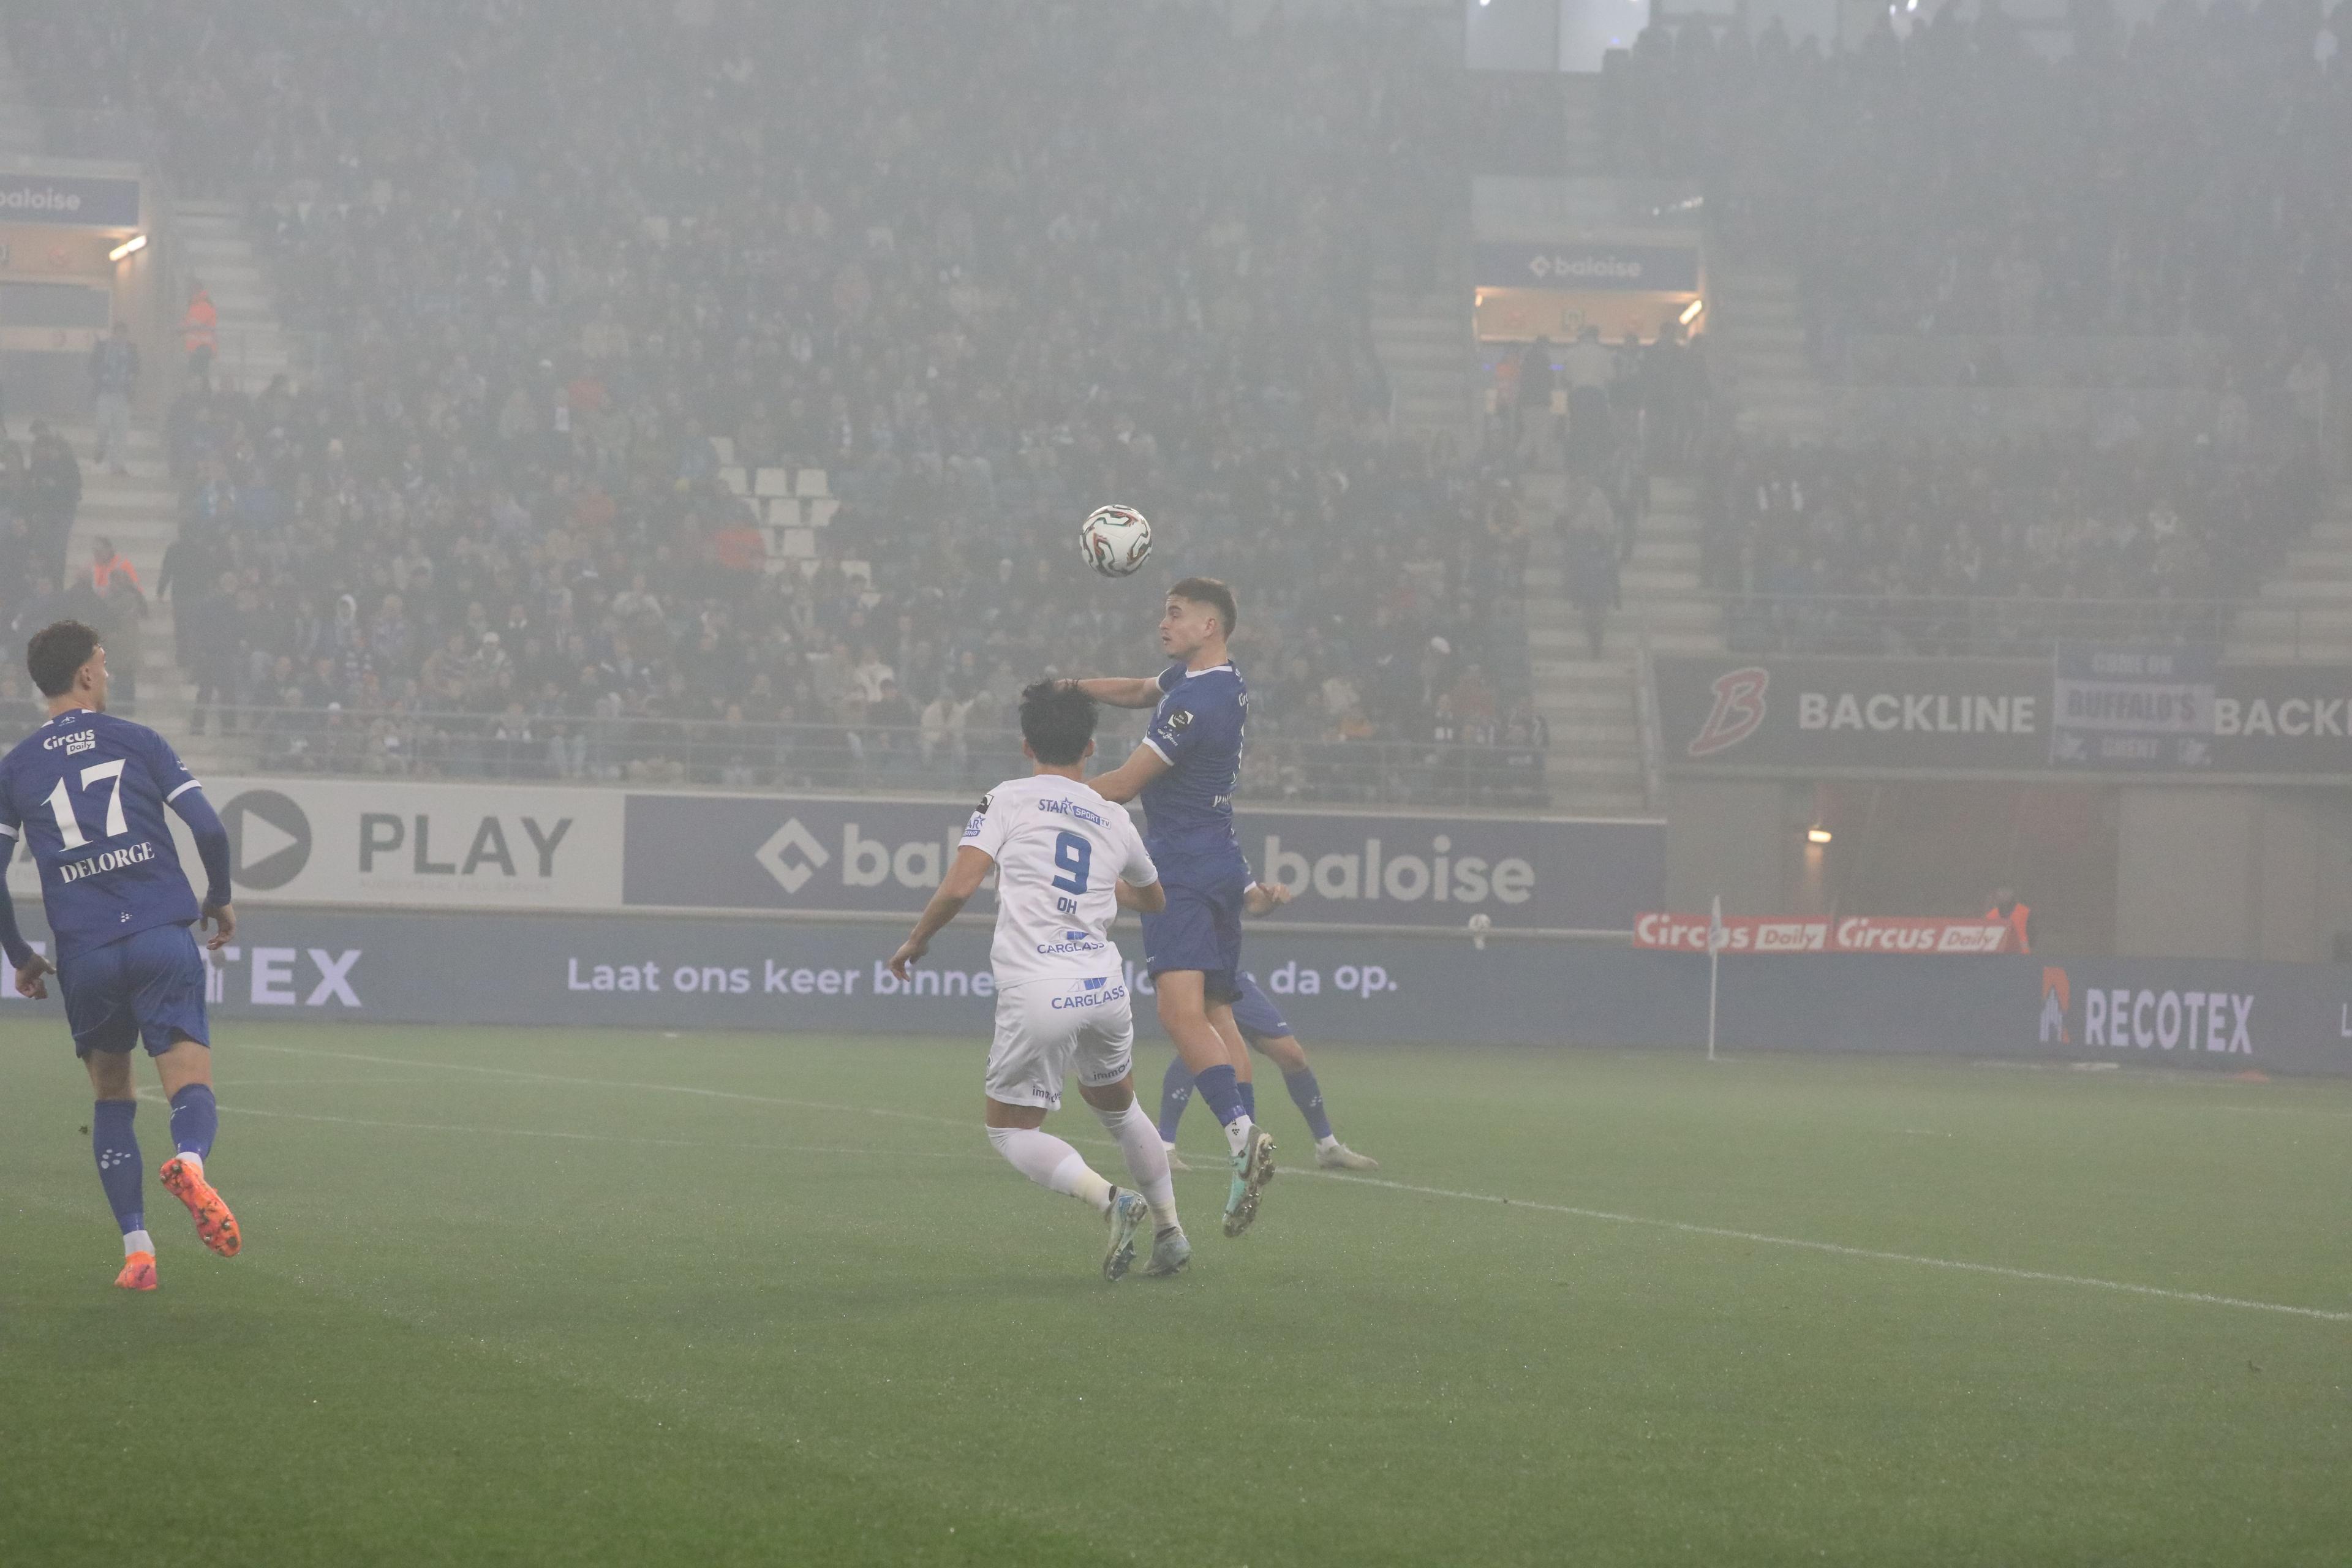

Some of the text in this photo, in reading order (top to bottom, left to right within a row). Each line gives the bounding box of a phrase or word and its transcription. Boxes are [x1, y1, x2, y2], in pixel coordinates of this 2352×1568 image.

[1555, 256, 1642, 278] baloise
[1800, 693, 2036, 733] BACKLINE
[43, 729, 95, 751] Circus
[69, 742, 92, 752] Daily
[41, 759, 129, 853] 17
[1038, 799, 1069, 816] STAR
[1075, 808, 1100, 824] SPORT
[360, 813, 574, 876] PLAY
[59, 842, 156, 884] DELORGE
[1051, 832, 1092, 895] 9
[1264, 834, 1536, 903] baloise
[1057, 897, 1077, 915] OH
[1765, 925, 1817, 949] Daily
[1838, 918, 1996, 950] Circus Daily
[568, 958, 660, 992] Laat
[673, 965, 751, 993] ons
[764, 959, 861, 995] keer
[1270, 962, 1321, 995] da
[1335, 965, 1398, 998] op.
[1051, 985, 1125, 1009] CARGLASS
[2085, 988, 2255, 1054] RECOTEX
[1093, 1058, 1130, 1080] immo
